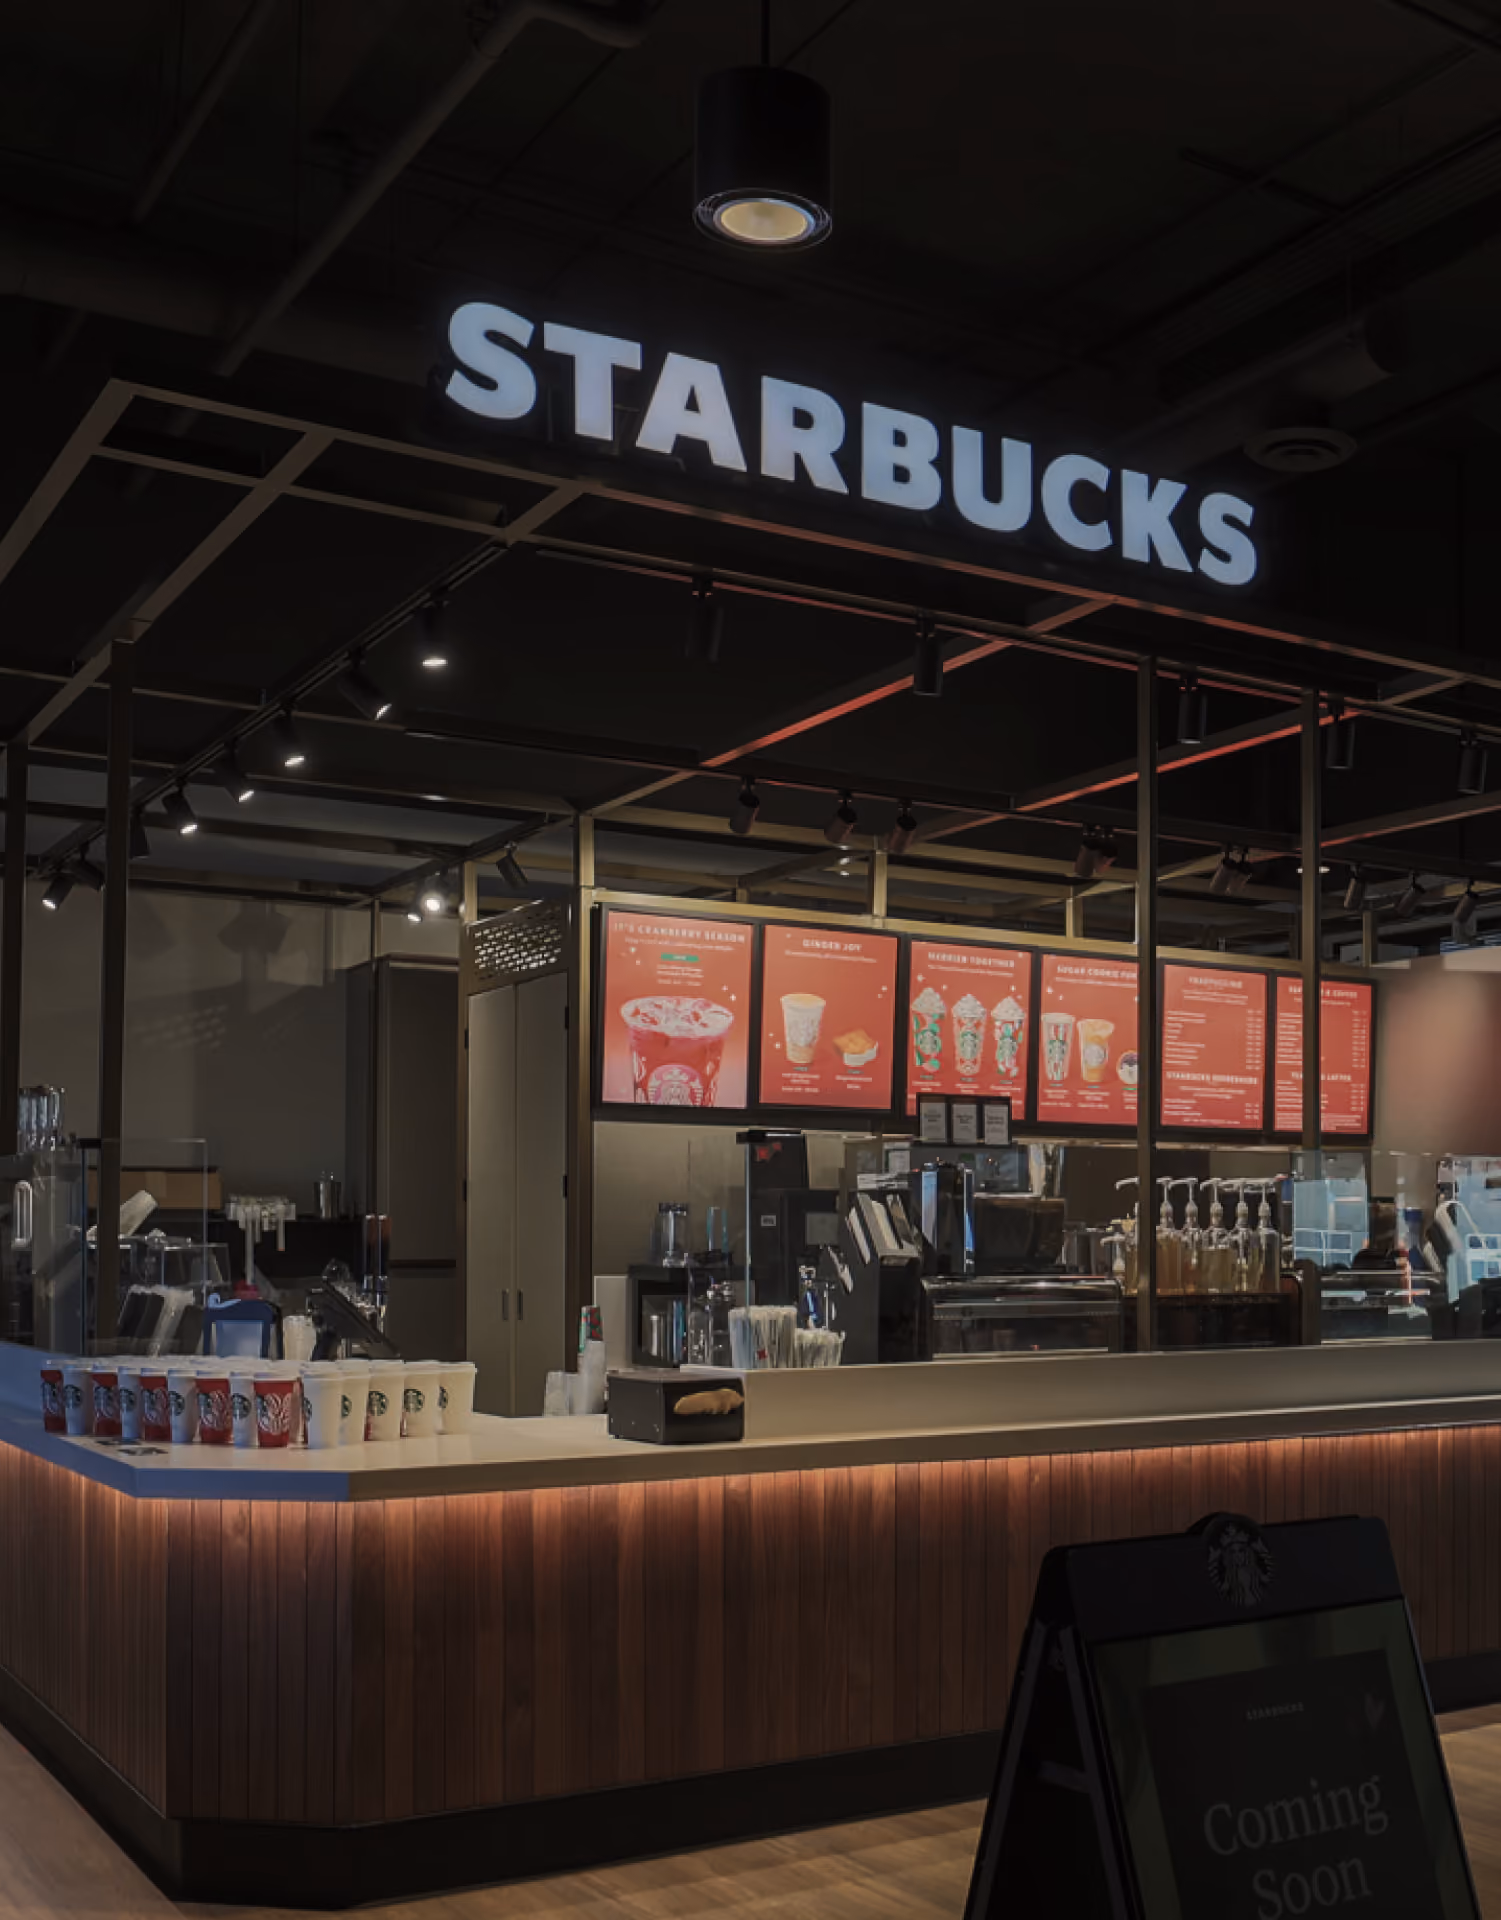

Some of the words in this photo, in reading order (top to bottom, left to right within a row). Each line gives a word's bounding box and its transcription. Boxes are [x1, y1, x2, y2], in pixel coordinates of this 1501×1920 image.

[445, 301, 1258, 586] STARBUCKS
[637, 925, 702, 939] CRANBERRY
[704, 930, 745, 944] SEASON
[1246, 1701, 1304, 1721] STARBUCKS
[1203, 1774, 1389, 1856] Coming
[1252, 1857, 1373, 1920] Soon
